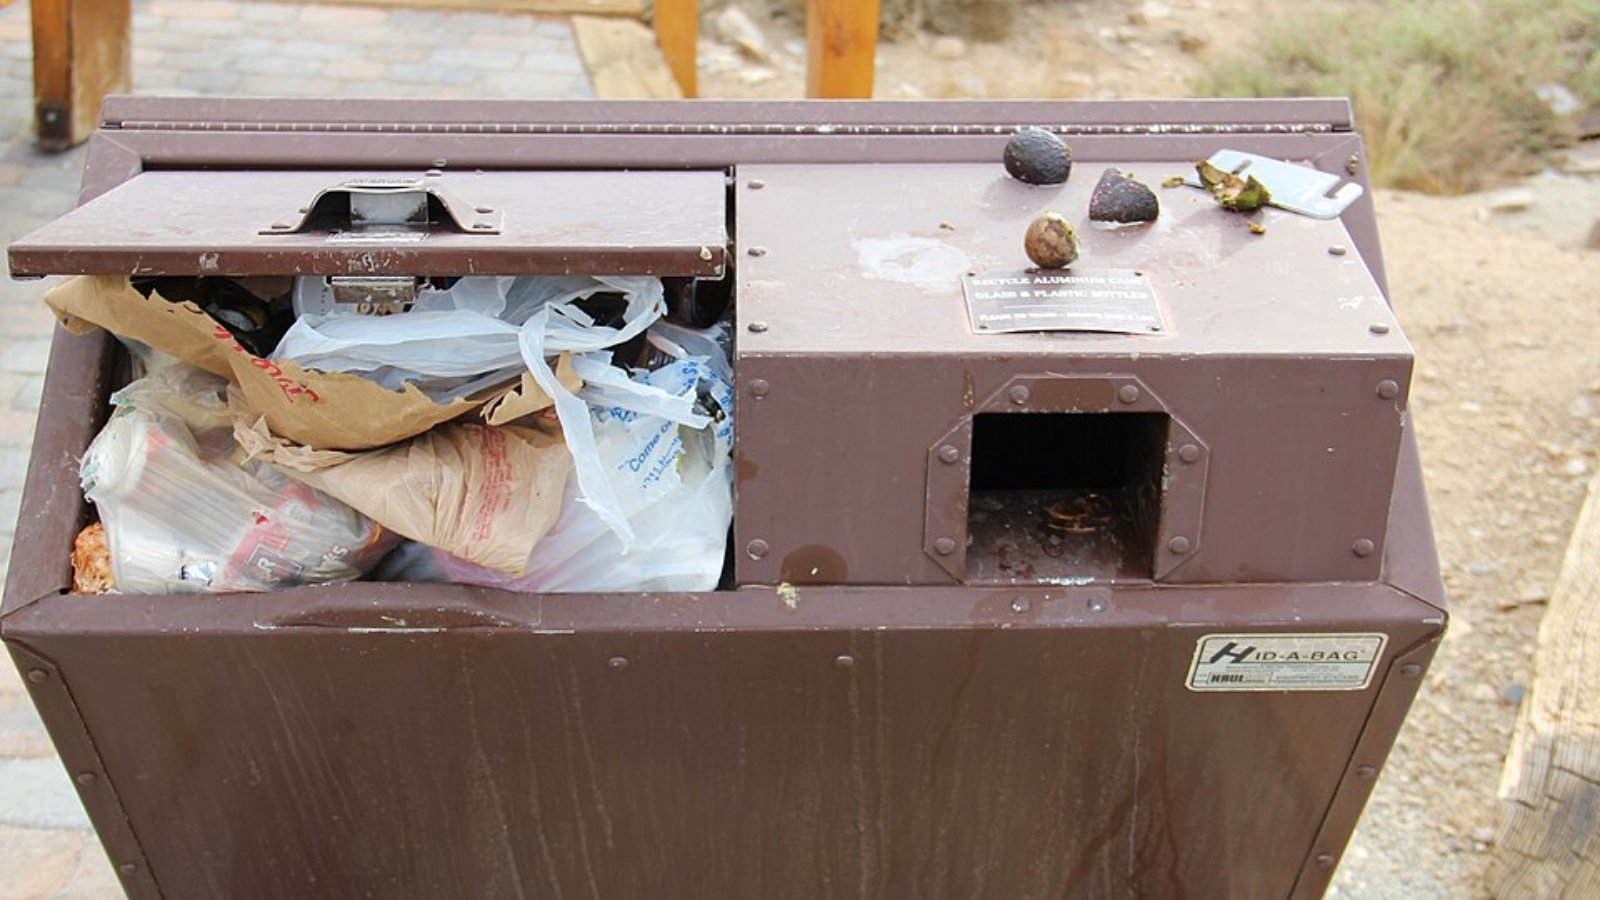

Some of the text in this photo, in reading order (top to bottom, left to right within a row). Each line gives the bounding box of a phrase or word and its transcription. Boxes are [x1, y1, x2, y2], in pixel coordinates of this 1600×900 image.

[973, 277, 1030, 286] RECYCLE
[1034, 276, 1106, 285] ALUMINUM
[974, 291, 1018, 299] GLASS
[1034, 290, 1088, 298] PLASTIC
[1090, 290, 1148, 299] BOTTLES
[629, 434, 660, 472] Come
